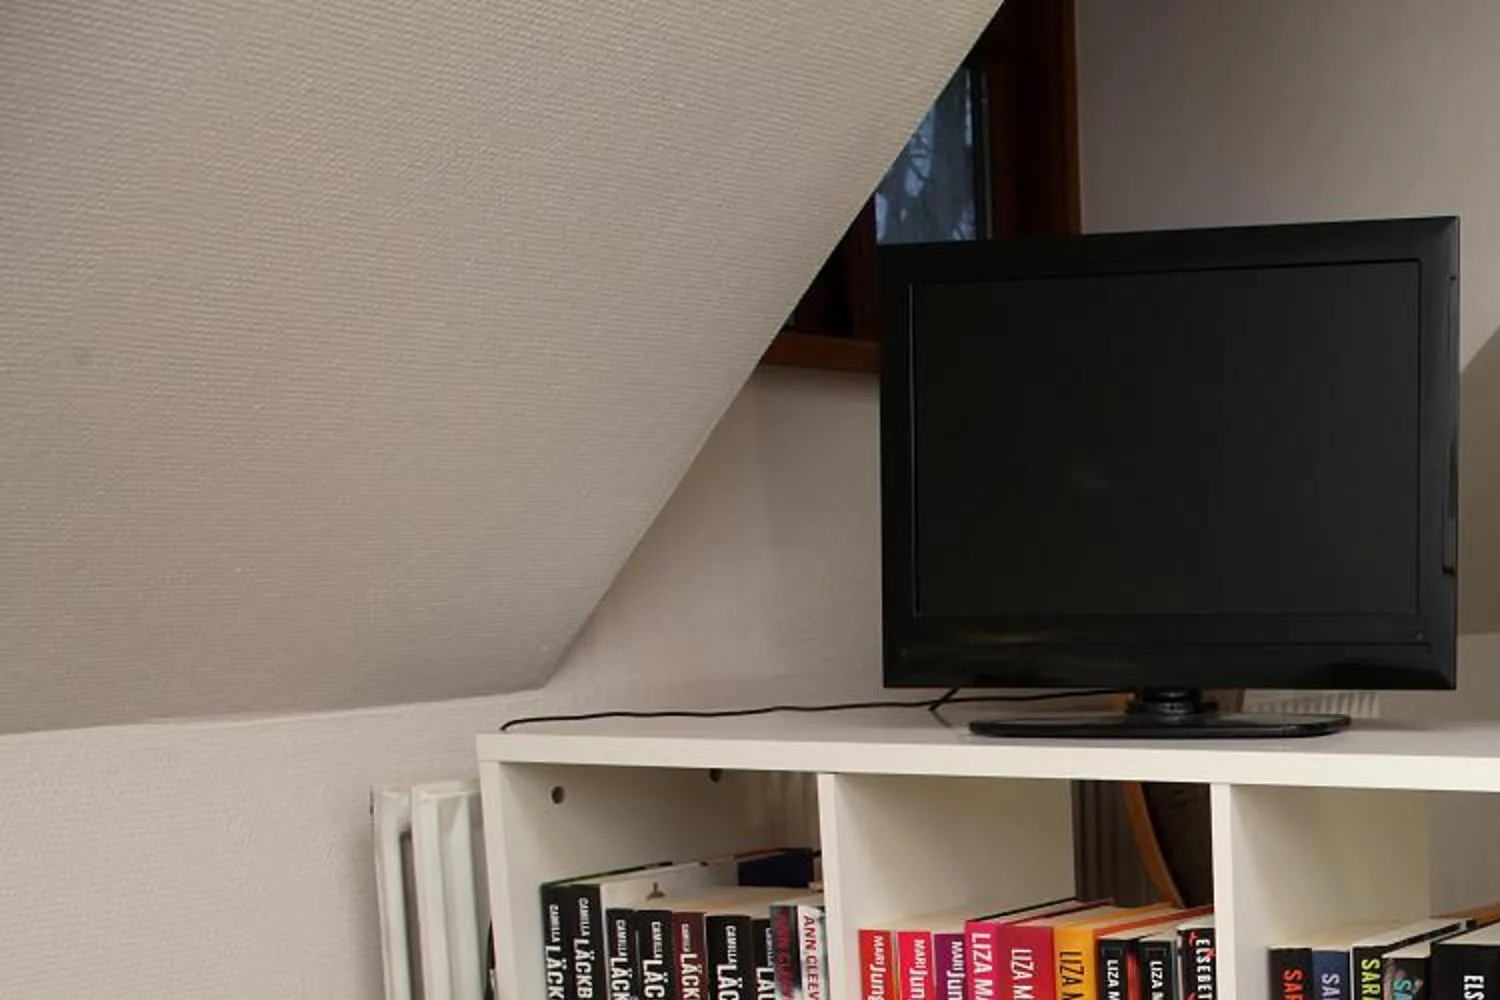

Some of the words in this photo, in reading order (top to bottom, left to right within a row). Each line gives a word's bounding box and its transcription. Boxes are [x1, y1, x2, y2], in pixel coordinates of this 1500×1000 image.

[725, 925, 737, 966] CAMILLA
[803, 915, 817, 951] ANN
[873, 936, 884, 967] MARI
[914, 940, 926, 968] MARI
[950, 941, 963, 971] MARI
[971, 932, 994, 973] LIZA
[1010, 948, 1034, 980] LIZA
[1059, 951, 1085, 985] LIZA
[1108, 960, 1120, 988] LIZA
[1150, 960, 1163, 989] LIZA
